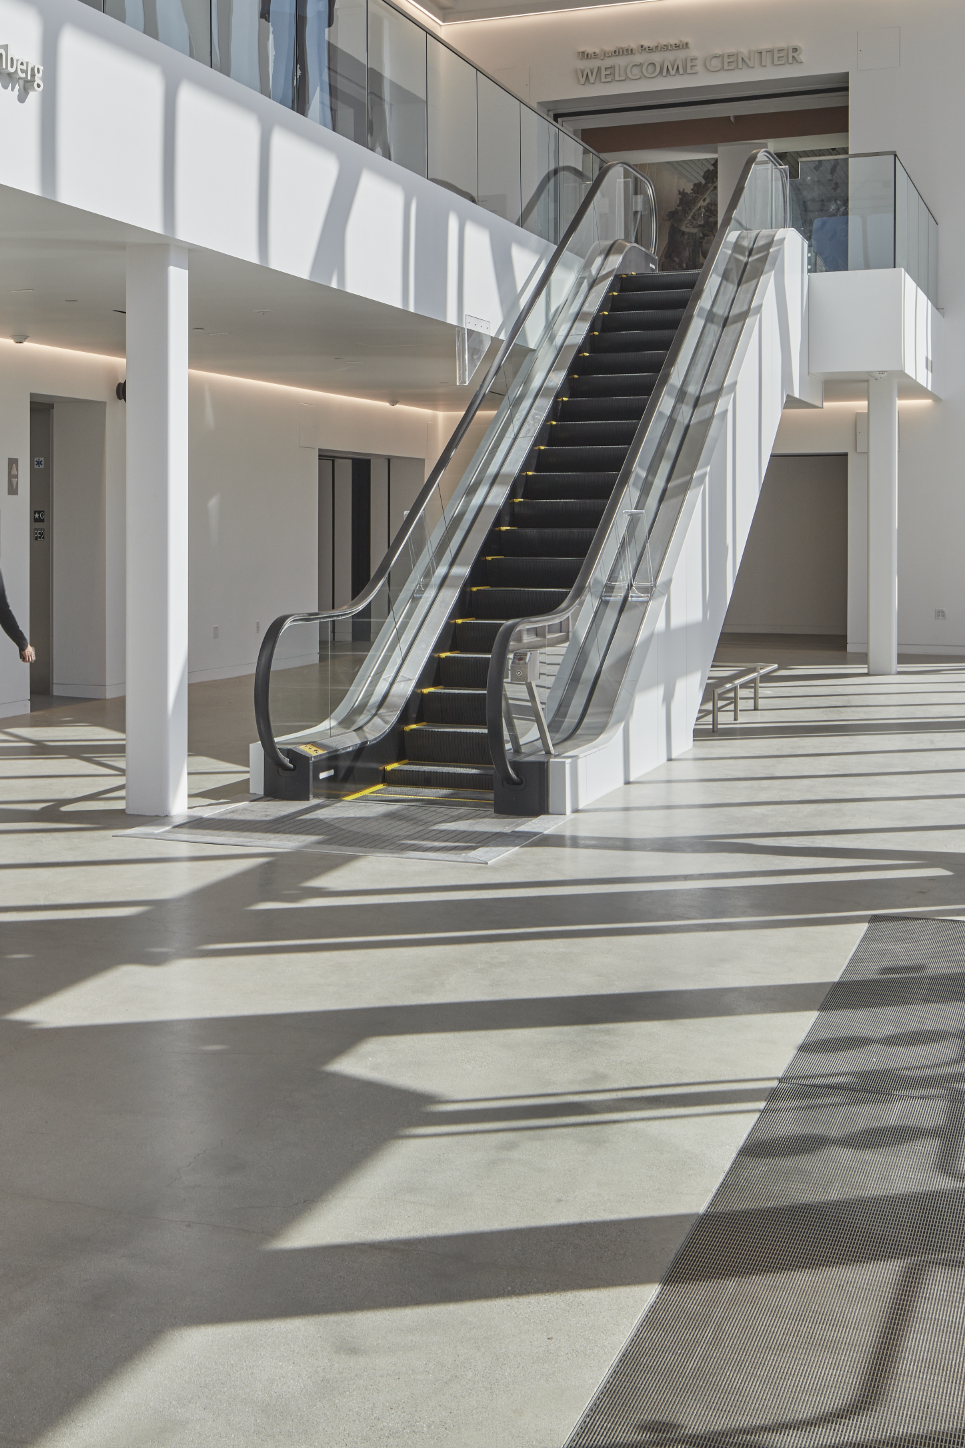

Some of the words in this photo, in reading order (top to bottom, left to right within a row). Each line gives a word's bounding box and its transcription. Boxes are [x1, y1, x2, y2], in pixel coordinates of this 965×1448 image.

[576, 55, 698, 85] WELCOME
[705, 45, 803, 72] CENTER
[578, 50, 598, 60] The
[600, 45, 635, 60] Judith
